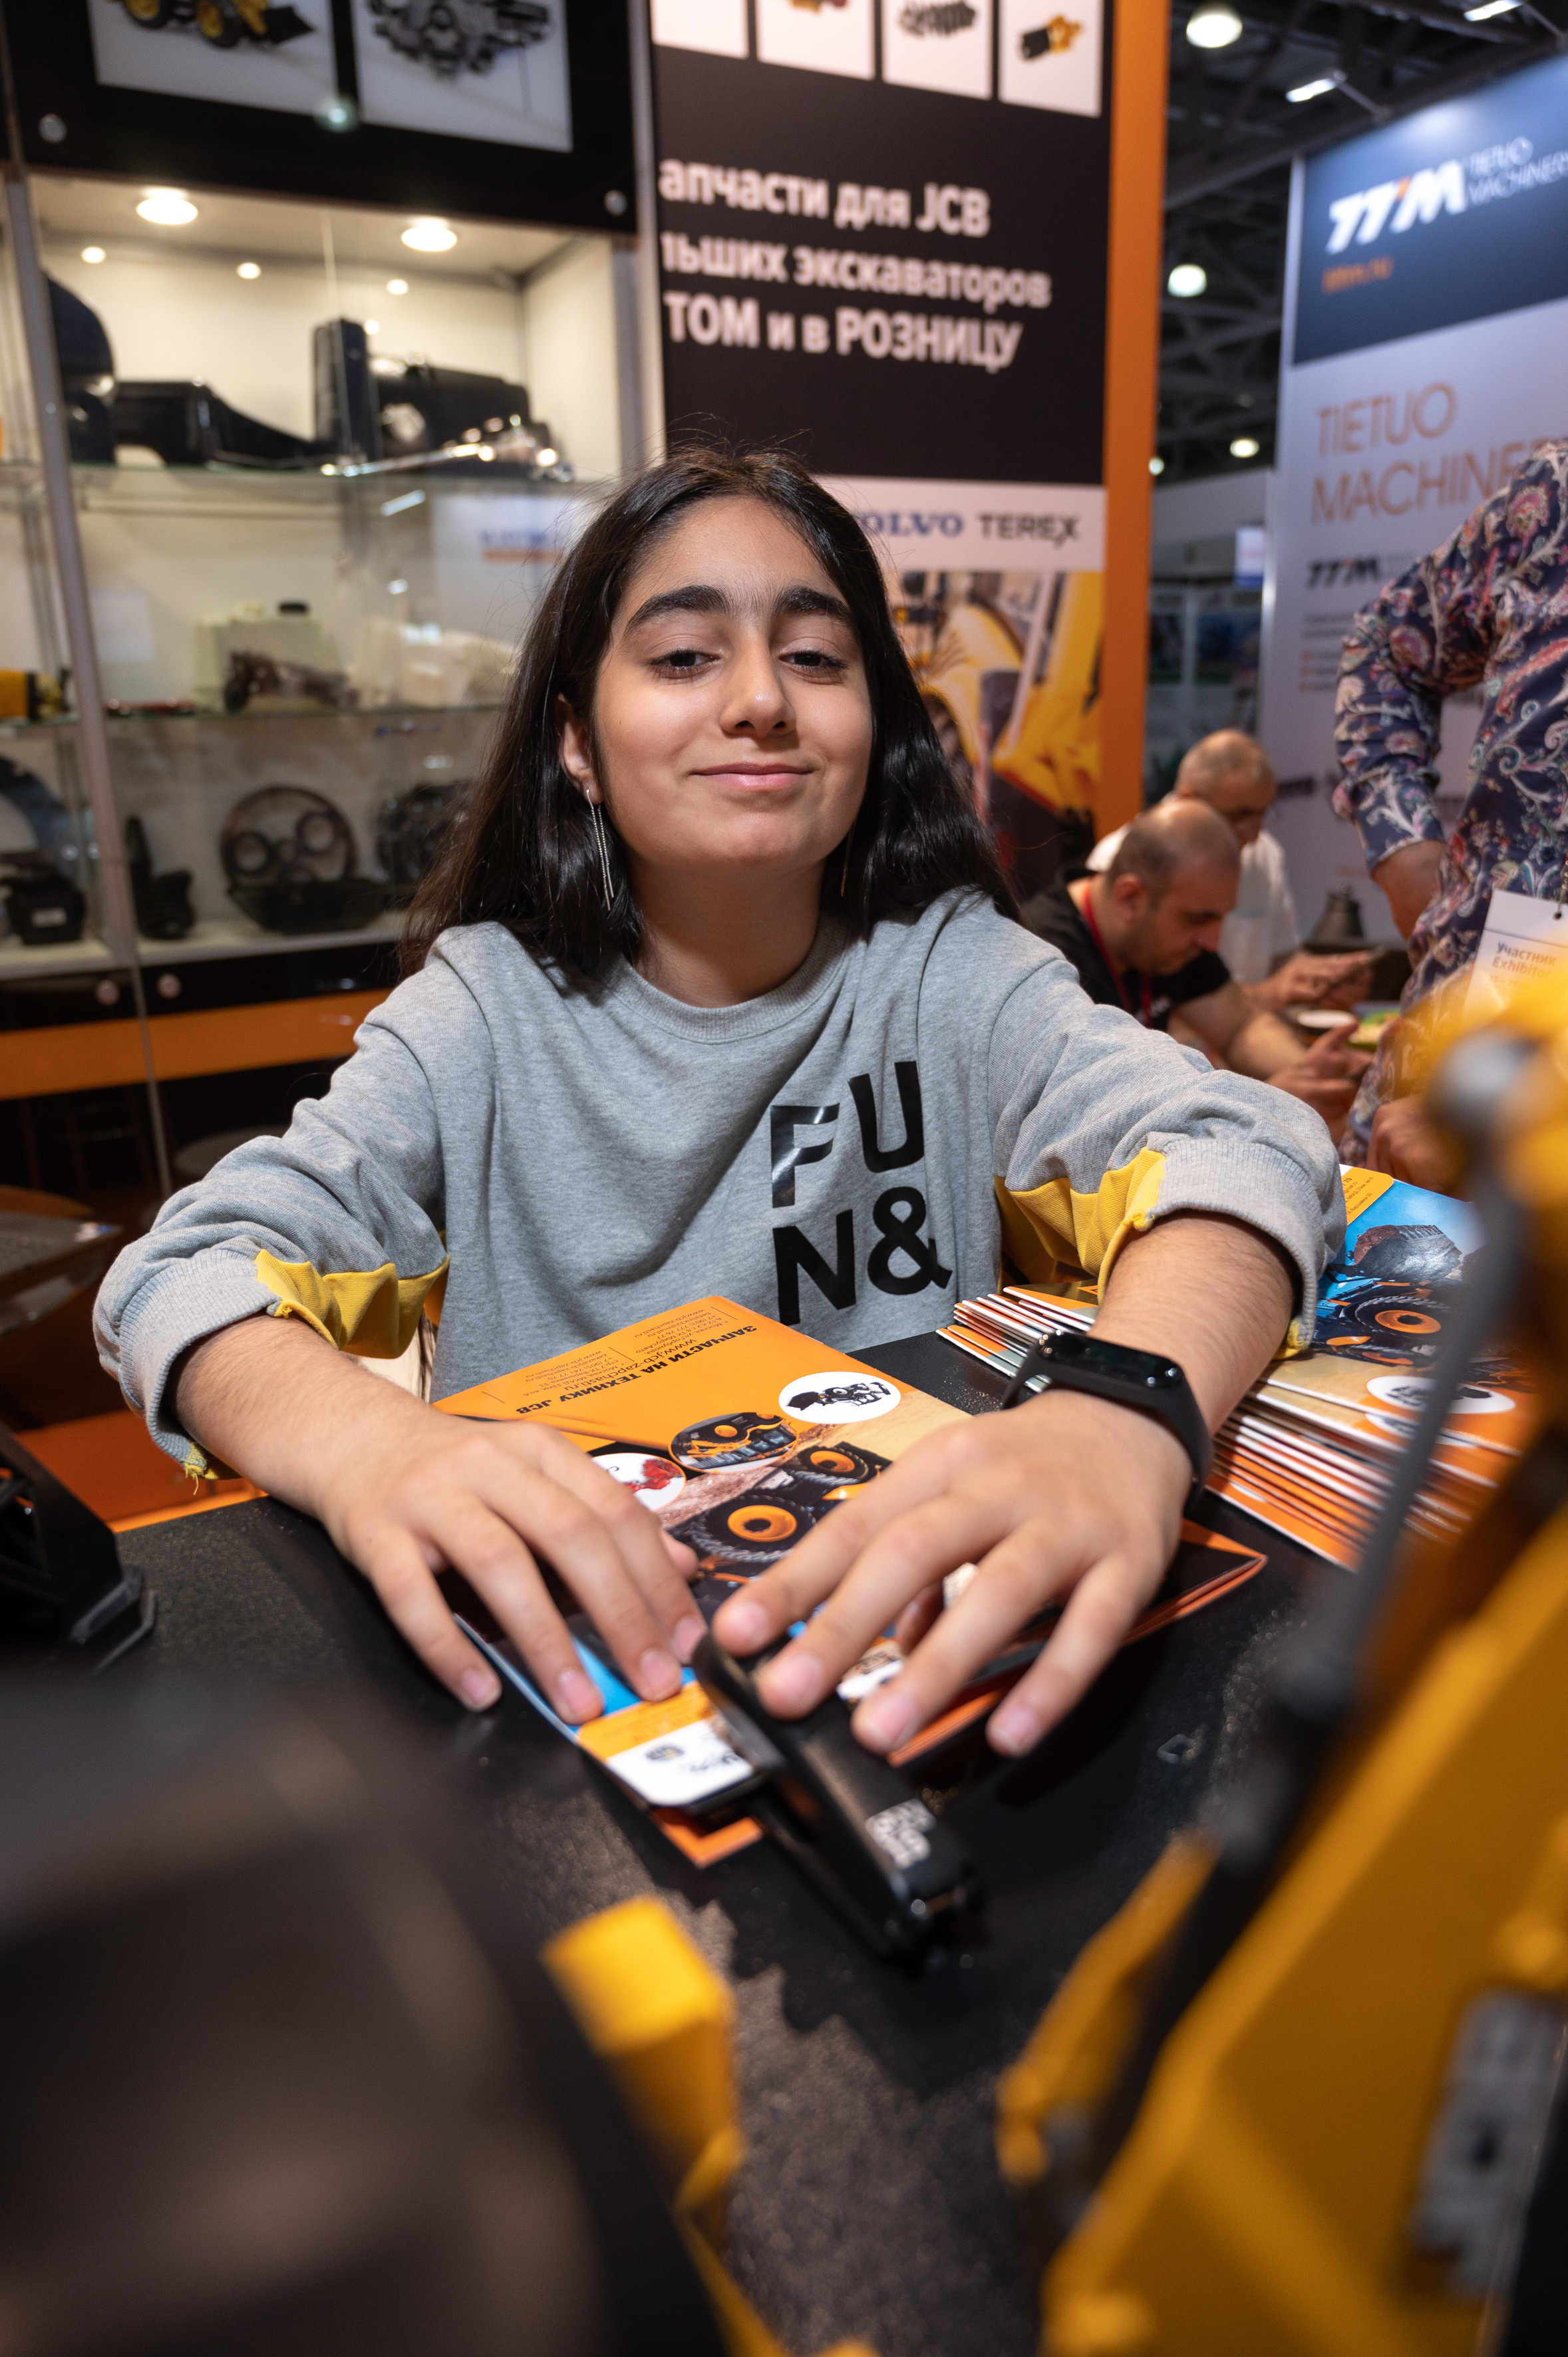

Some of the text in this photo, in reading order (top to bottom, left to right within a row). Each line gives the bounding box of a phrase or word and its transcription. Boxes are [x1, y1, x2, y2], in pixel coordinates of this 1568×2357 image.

[835, 183, 910, 231] для
[915, 183, 991, 237] JCB
[792, 246, 1053, 314] экскаваторов
[767, 311, 794, 351] и
[802, 315, 830, 354] в
[836, 307, 1024, 375] РОЗНИЦУ
[1315, 383, 1458, 458] TIETUO
[1311, 439, 1553, 526] MACHINE
[854, 510, 965, 538] OLVO
[976, 512, 1080, 549] TEREX
[516, 1326, 757, 1414] ЗАПЧАСТИ НА ТЕХНИКУ JCB
[564, 1339, 697, 1391] www.jcb-zapchasti.ru
